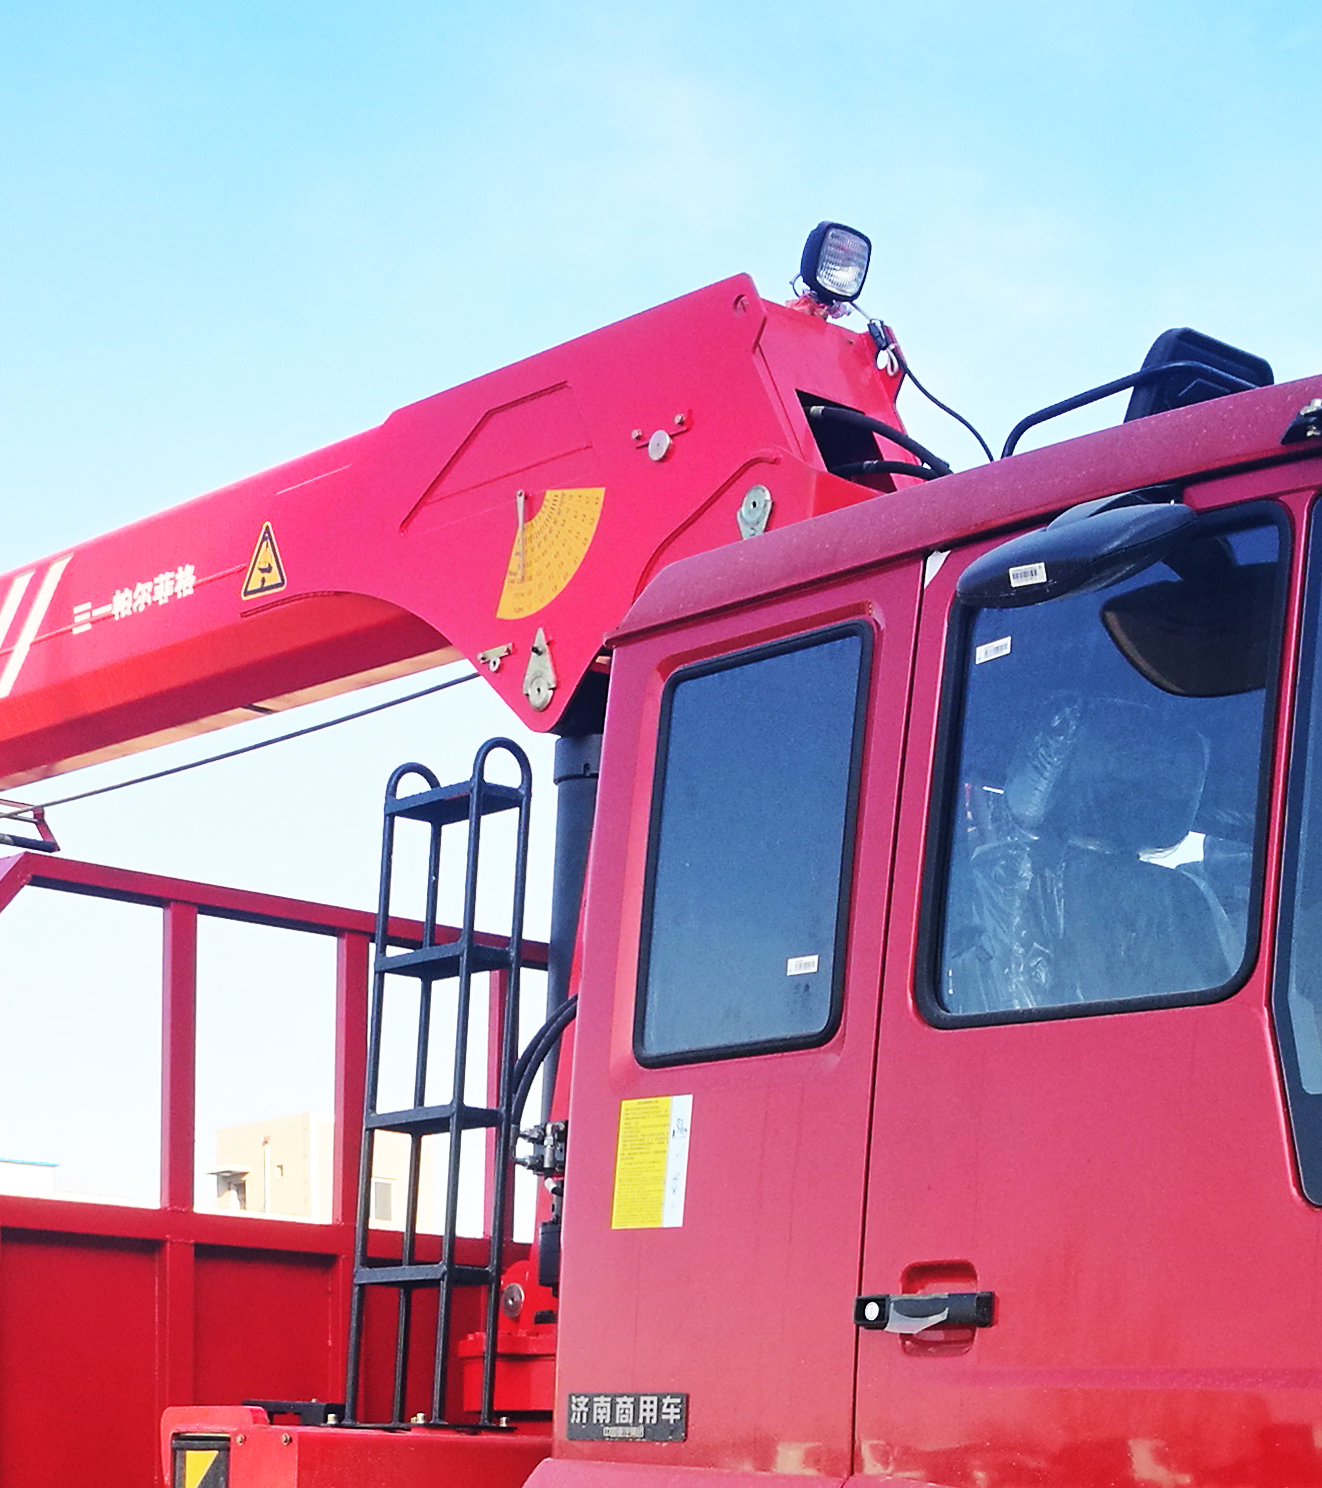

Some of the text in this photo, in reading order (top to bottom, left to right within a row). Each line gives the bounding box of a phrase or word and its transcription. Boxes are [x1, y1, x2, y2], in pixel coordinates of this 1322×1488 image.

[72, 563, 196, 634] 三一帕尔菲格
[570, 1395, 681, 1424] 济南商用车
